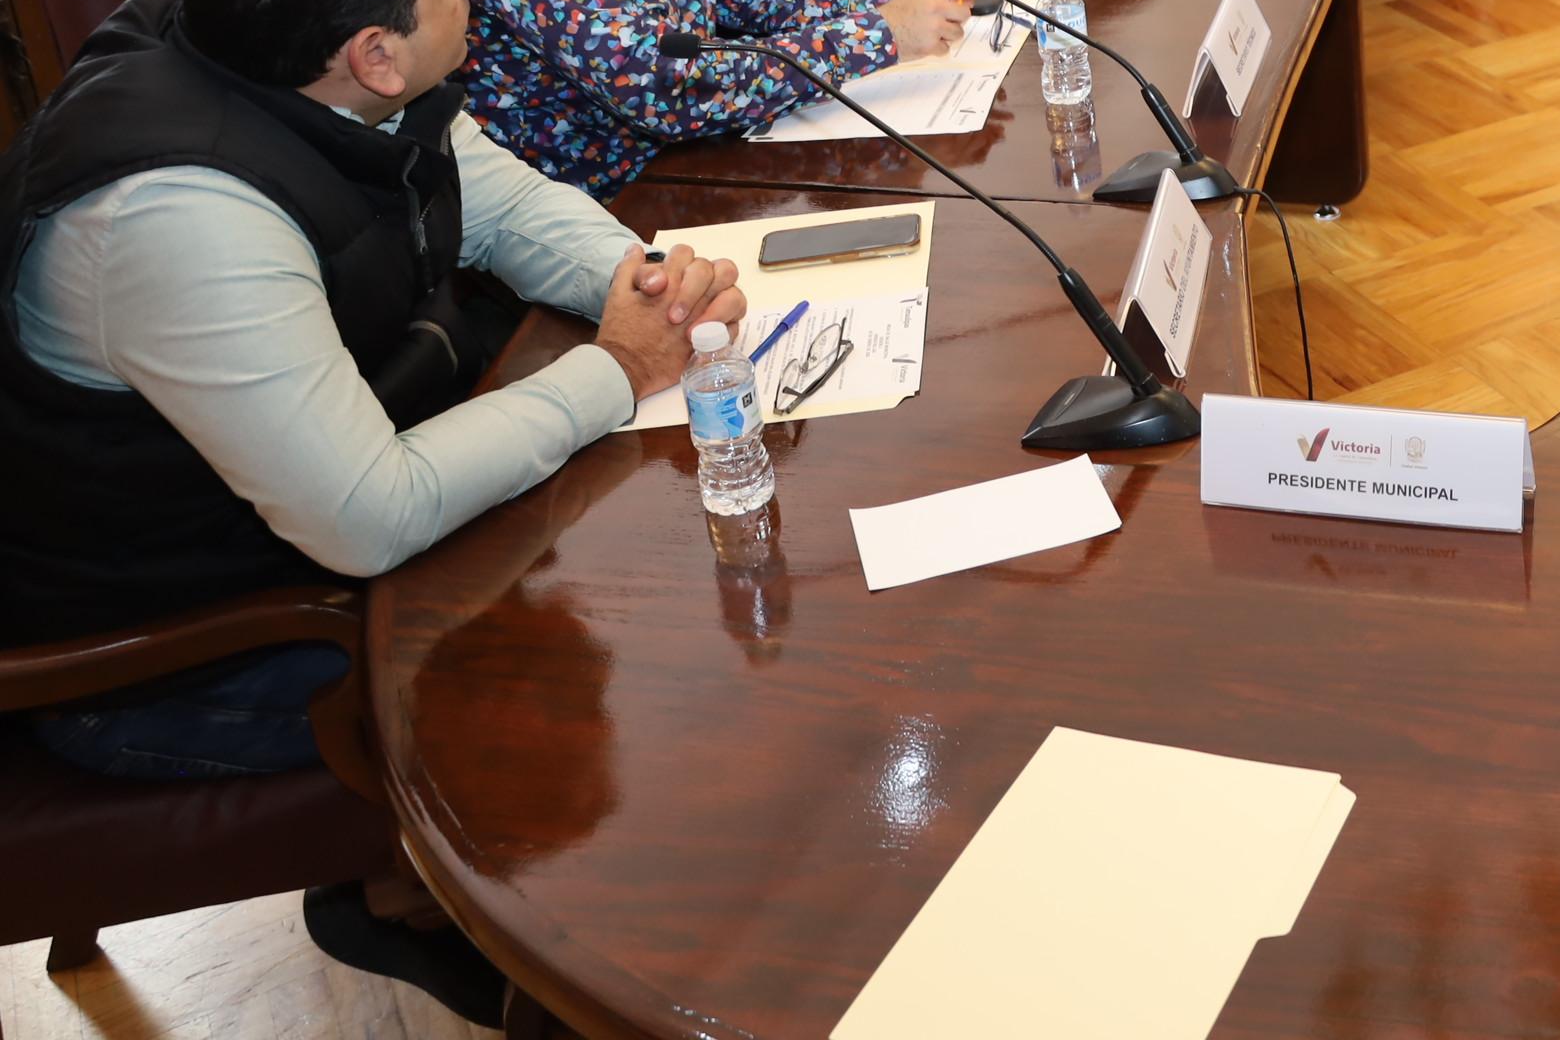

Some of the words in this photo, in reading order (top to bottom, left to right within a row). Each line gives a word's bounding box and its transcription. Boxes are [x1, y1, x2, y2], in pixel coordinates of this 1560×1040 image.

[1331, 439, 1381, 455] Victoria
[1268, 472, 1367, 494] PRESIDENTE
[1372, 480, 1459, 502] MUNICIPAL
